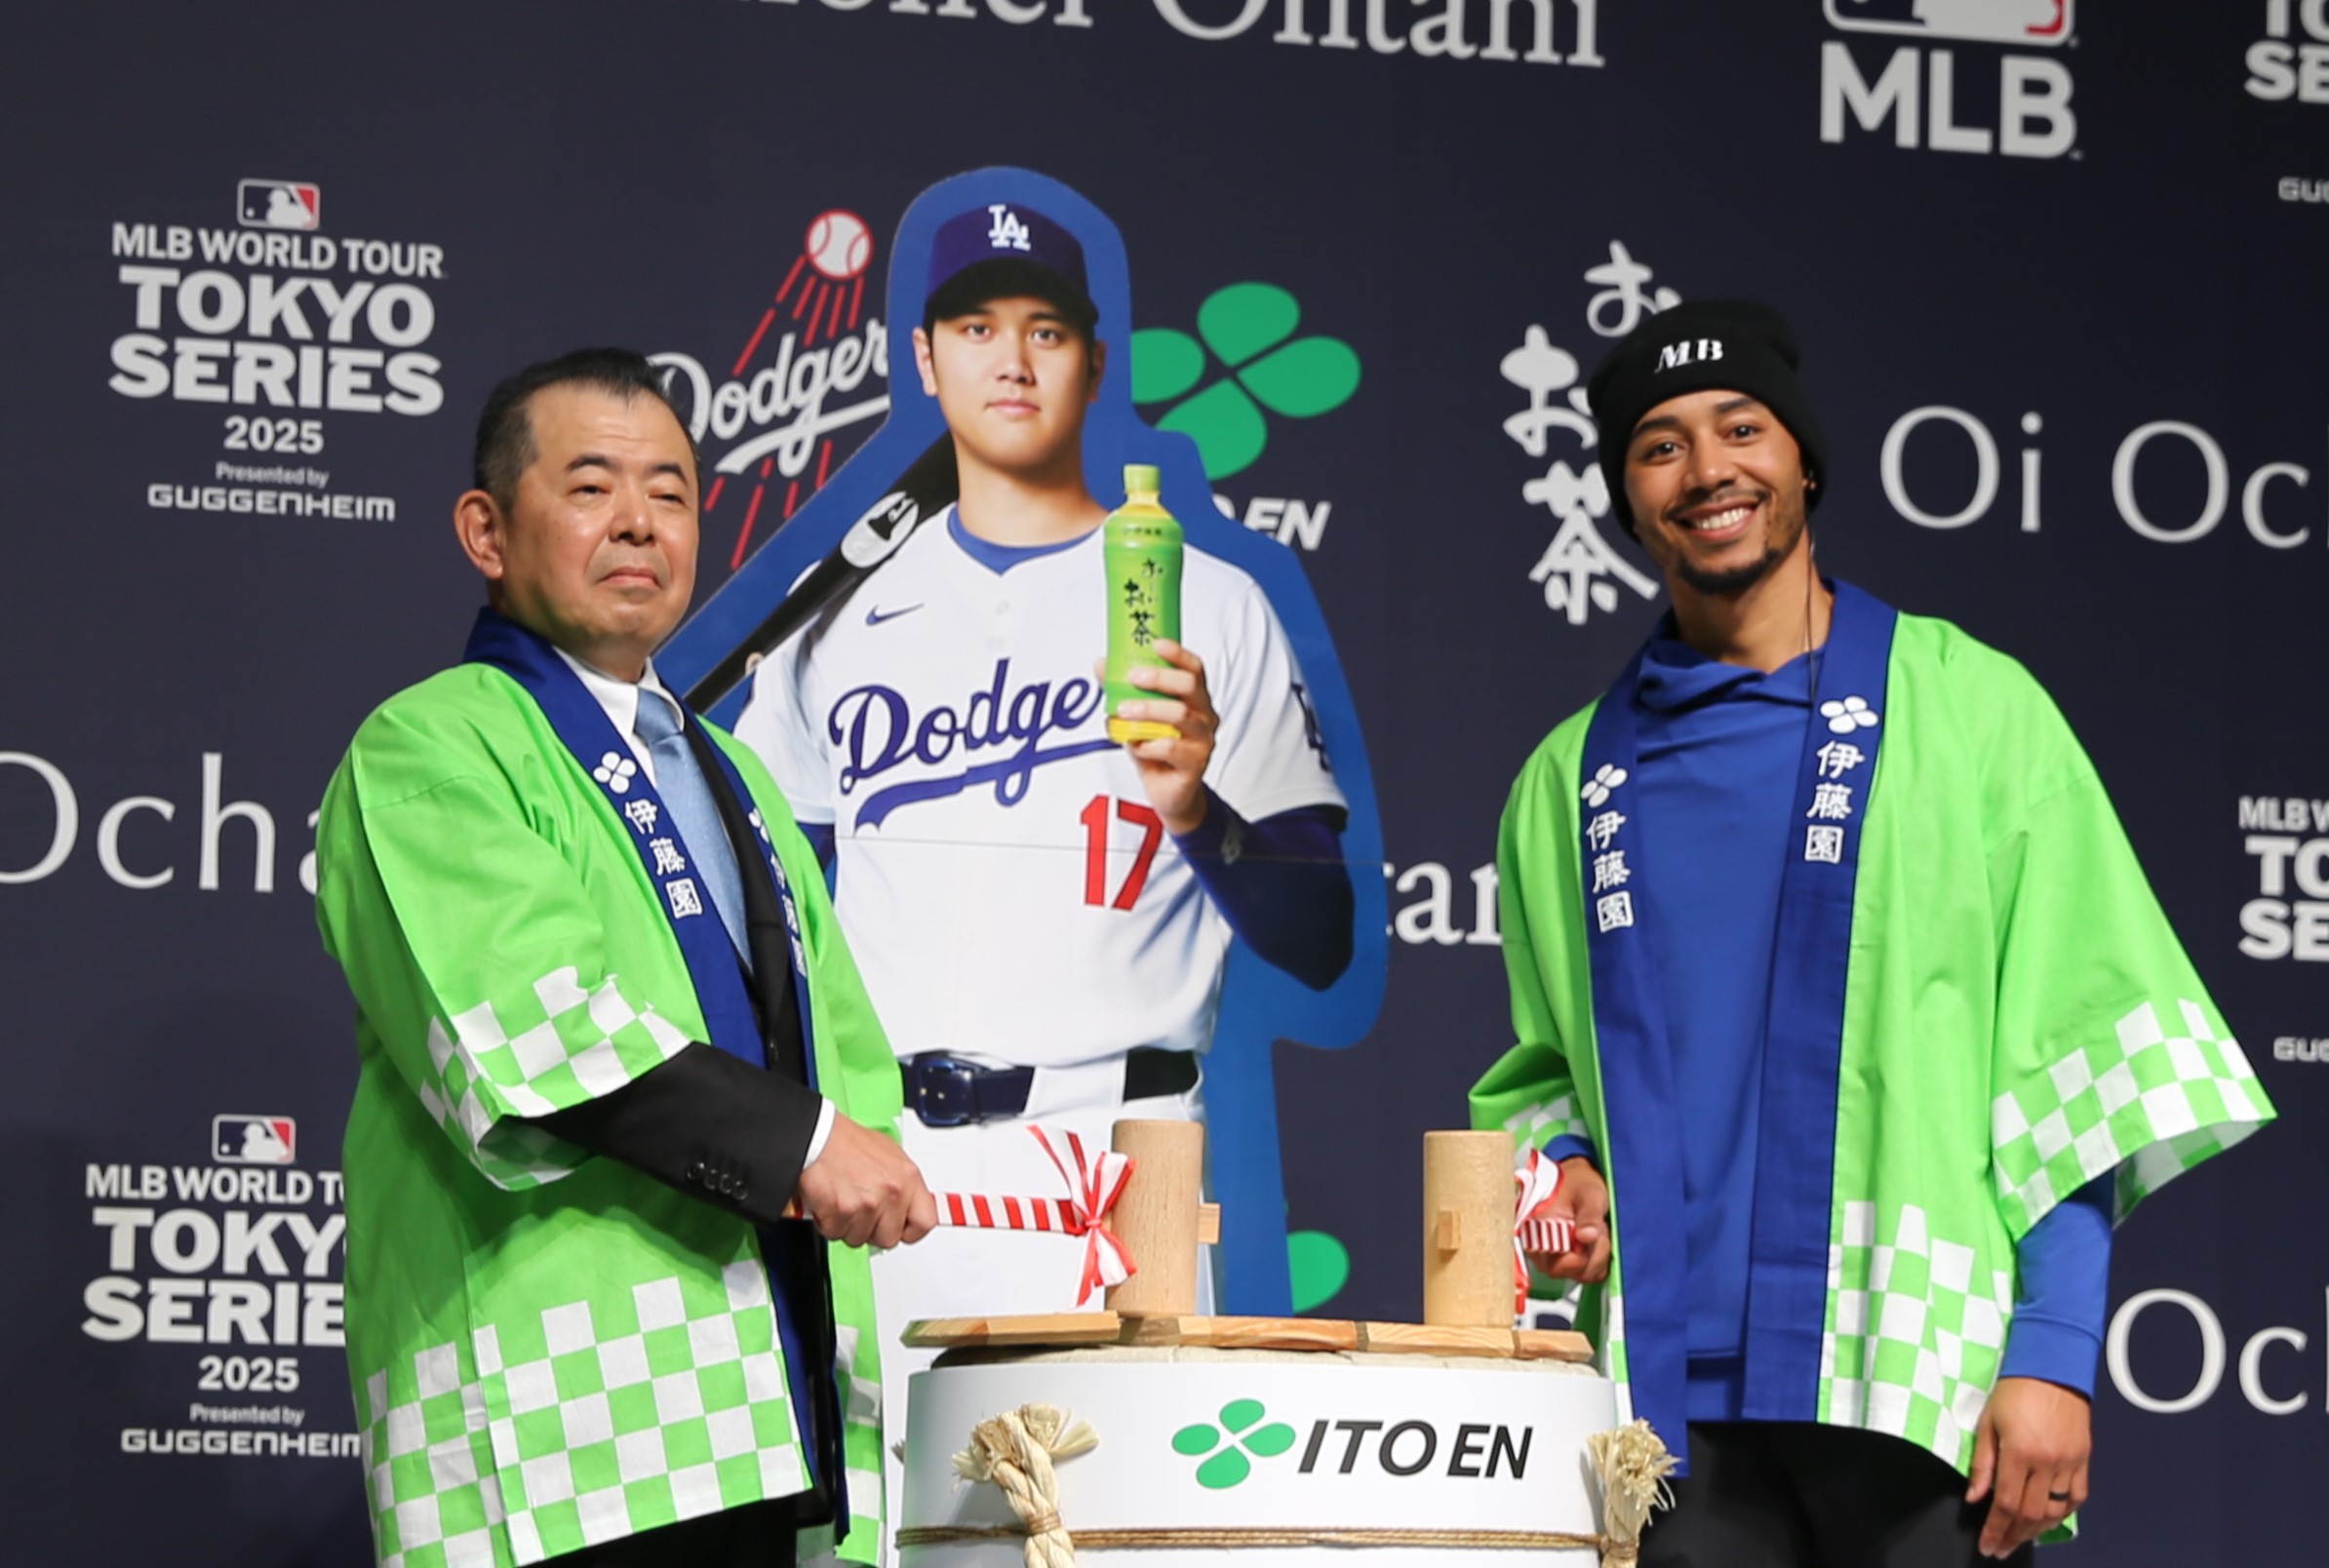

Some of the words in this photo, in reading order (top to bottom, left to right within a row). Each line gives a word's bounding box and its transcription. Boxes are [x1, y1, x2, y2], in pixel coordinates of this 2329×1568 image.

[1820, 41, 2077, 157] MLB
[111, 221, 194, 261] MLB
[198, 227, 338, 271] WORLD
[341, 238, 445, 280] TOUR
[988, 204, 1031, 252] LA
[118, 264, 436, 348] TOKYO
[108, 333, 445, 416] SERIES
[1654, 337, 1724, 374] MB
[223, 414, 325, 455] 2025
[147, 483, 396, 523] GUGGENHEIM
[215, 460, 306, 486] Presented
[306, 467, 330, 490] by
[1879, 406, 2042, 532] Oi
[2112, 420, 2329, 549] Oc
[1804, 739, 1866, 864] 伊藤園
[2238, 796, 2310, 832] MLB
[624, 798, 704, 920] 伊藤園
[1080, 794, 1164, 912] 17
[1586, 809, 1635, 933] 伊藤園
[85, 1163, 169, 1200] MLB
[173, 1165, 314, 1204] WORLD
[92, 1206, 347, 1277] TOKY
[197, 1354, 300, 1393] 2025
[2106, 1286, 2329, 1415] Oc
[189, 1402, 281, 1425] Presented
[282, 1406, 305, 1428] by
[1298, 1420, 1438, 1476] ITO
[1446, 1423, 1533, 1480] EN
